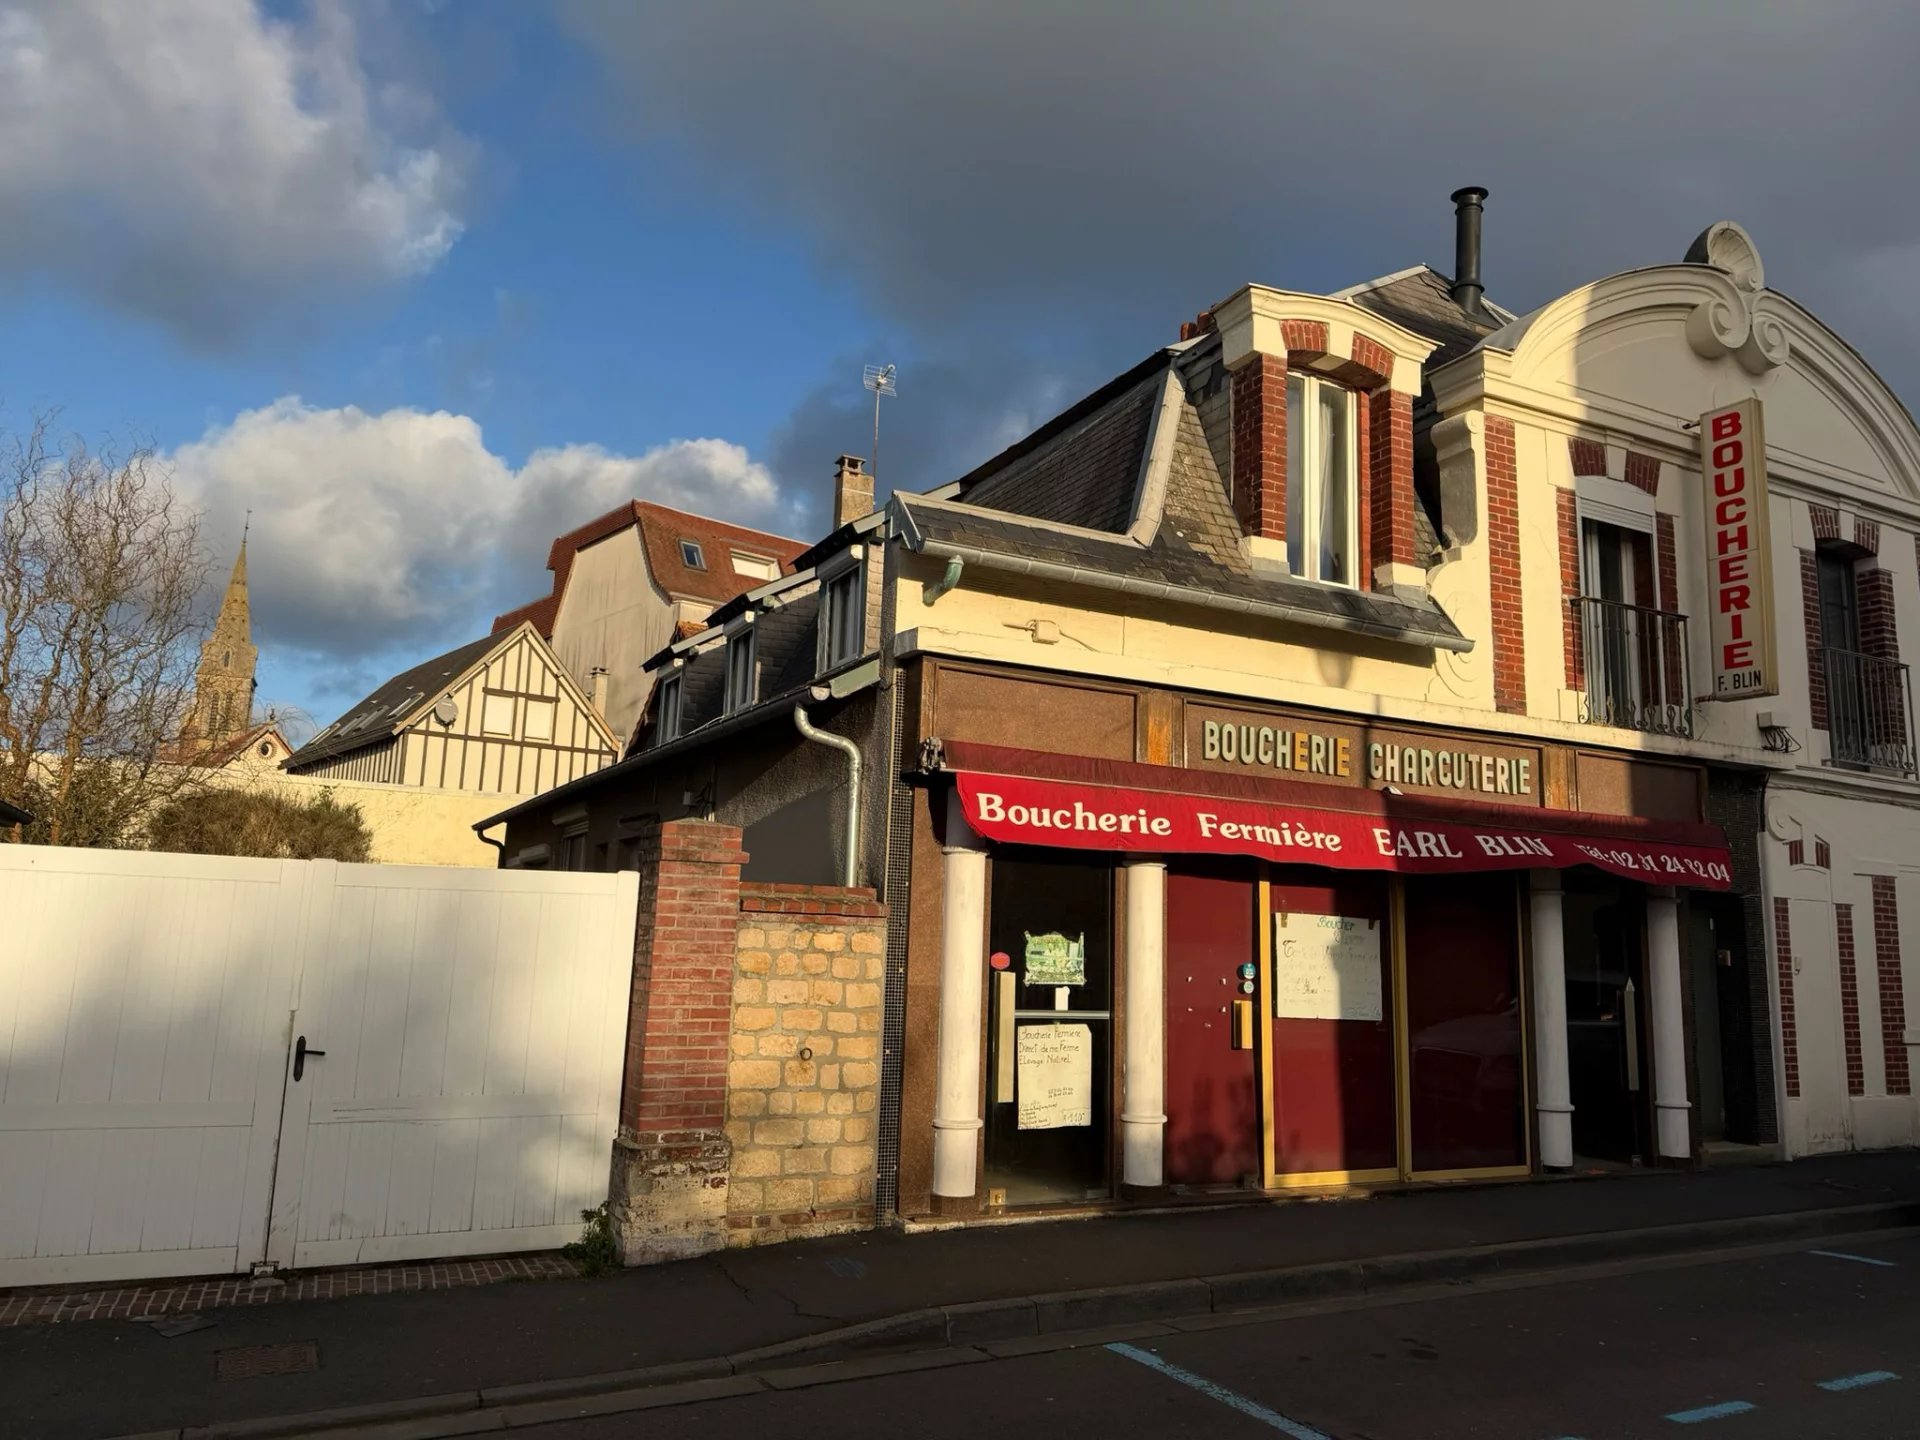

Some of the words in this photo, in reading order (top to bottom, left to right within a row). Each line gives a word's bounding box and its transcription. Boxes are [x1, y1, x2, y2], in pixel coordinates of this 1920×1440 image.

[1711, 411, 1753, 670] BOUCHERIE
[1718, 675, 1729, 692] F.
[1732, 670, 1762, 690] BLIN
[1202, 719, 1350, 777] BOUCHERIE
[1368, 742, 1531, 795] CHARCUTERIE
[976, 792, 1173, 836] Boucherie
[1196, 811, 1342, 852] Fermière
[1372, 827, 1463, 859] EARL
[1474, 834, 1554, 858] BLIN
[1660, 854, 1687, 874] 24
[1707, 861, 1732, 882] 04
